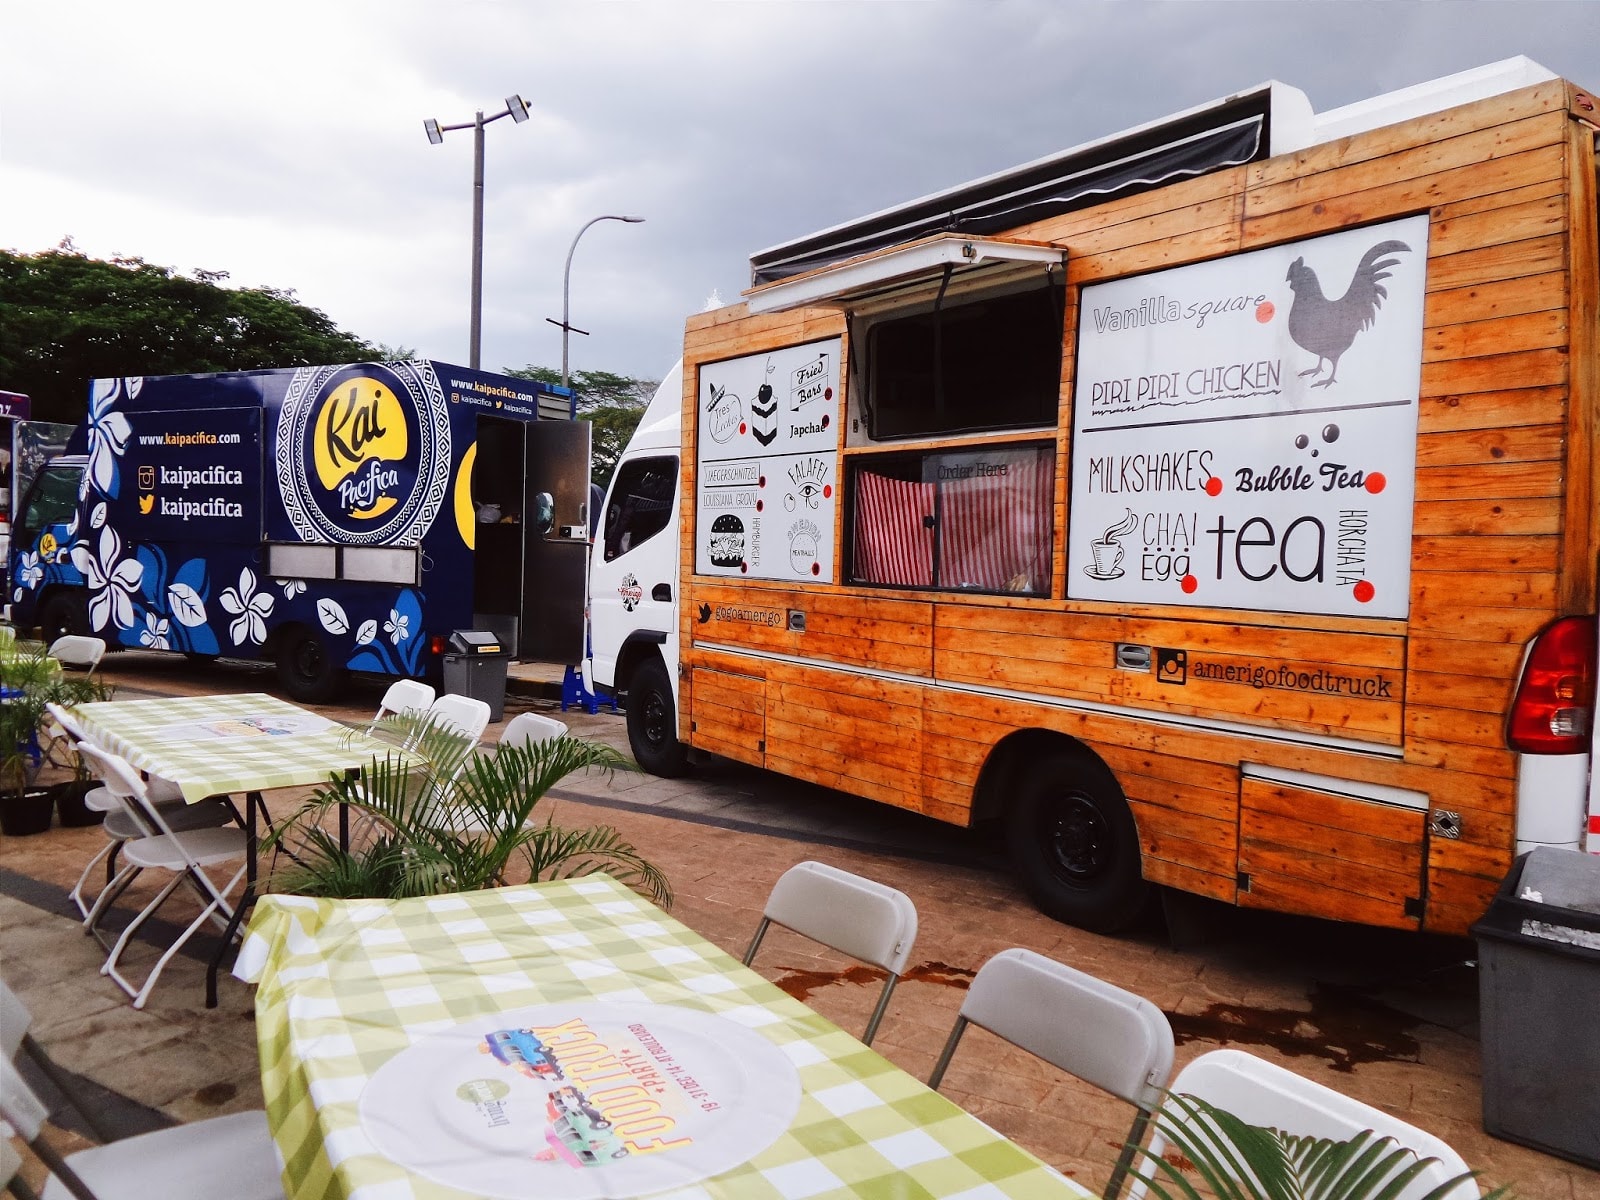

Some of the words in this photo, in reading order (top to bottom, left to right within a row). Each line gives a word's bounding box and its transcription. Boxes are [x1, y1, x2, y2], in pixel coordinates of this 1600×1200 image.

[1094, 295, 1181, 334] Vanilla
[1183, 293, 1266, 328] square
[797, 361, 823, 385] Fried
[1092, 378, 1131, 406] PIRI
[1138, 372, 1180, 402] PIRI
[1187, 360, 1281, 396] CHICKEN
[451, 379, 533, 403] www.kaipacifica.com
[461, 394, 492, 407] kaipacifica
[503, 403, 532, 415] kaipacifica
[798, 384, 822, 404] Bars
[139, 431, 241, 447] www.kaipacifica.com
[326, 387, 387, 468] Kai
[790, 422, 826, 439] Japchae
[161, 466, 243, 489] kaipacifica
[338, 460, 399, 509] Pacifica
[788, 457, 829, 486] FALAFEL
[937, 463, 973, 479] Order
[976, 462, 1008, 477] Here
[1089, 450, 1214, 494] MILKSHAKES
[1235, 465, 1315, 492] Bubble
[1319, 462, 1367, 492] Tea
[161, 497, 243, 521] kaipacifica
[703, 493, 733, 507] LOUISIANA
[752, 517, 761, 568] HAMBURGER
[1143, 513, 1198, 547] CHAI
[1206, 515, 1326, 583] tea
[1336, 510, 1369, 586] HORCHATA
[1142, 554, 1191, 582] Egg
[716, 606, 781, 627] gogoamerigo
[1194, 660, 1392, 698] amerigofoodtruck
[531, 1017, 635, 1089] TRUCK
[617, 1054, 666, 1088] PARTY
[676, 1076, 699, 1090] DEC
[589, 1084, 694, 1157] FOOD
[701, 1101, 721, 1112] 19
